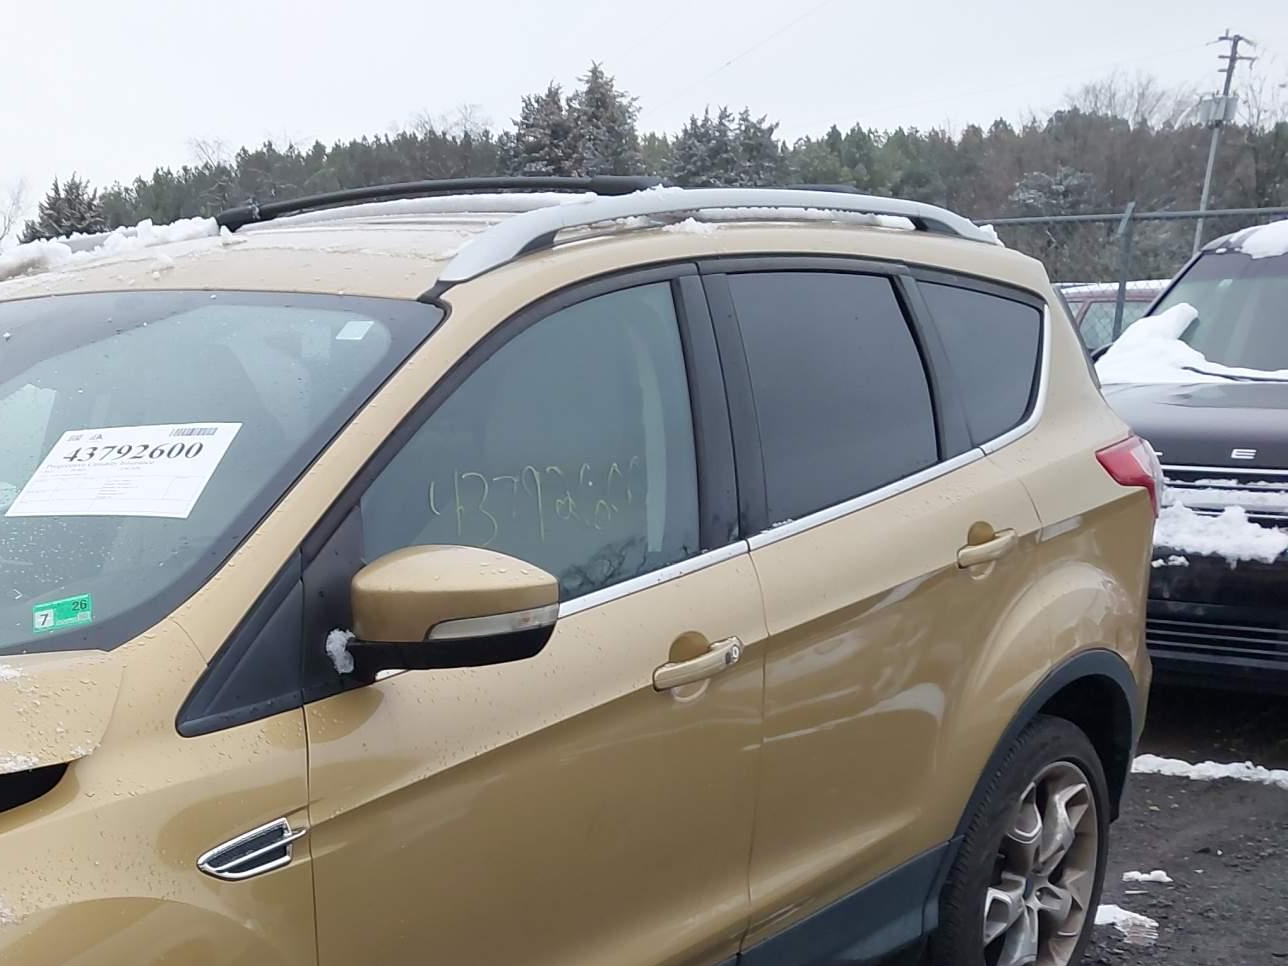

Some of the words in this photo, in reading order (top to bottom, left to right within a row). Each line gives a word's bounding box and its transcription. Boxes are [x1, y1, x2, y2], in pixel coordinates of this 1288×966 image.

[63, 442, 204, 462] 43792600
[72, 599, 88, 612] 26
[39, 613, 49, 626] 7
